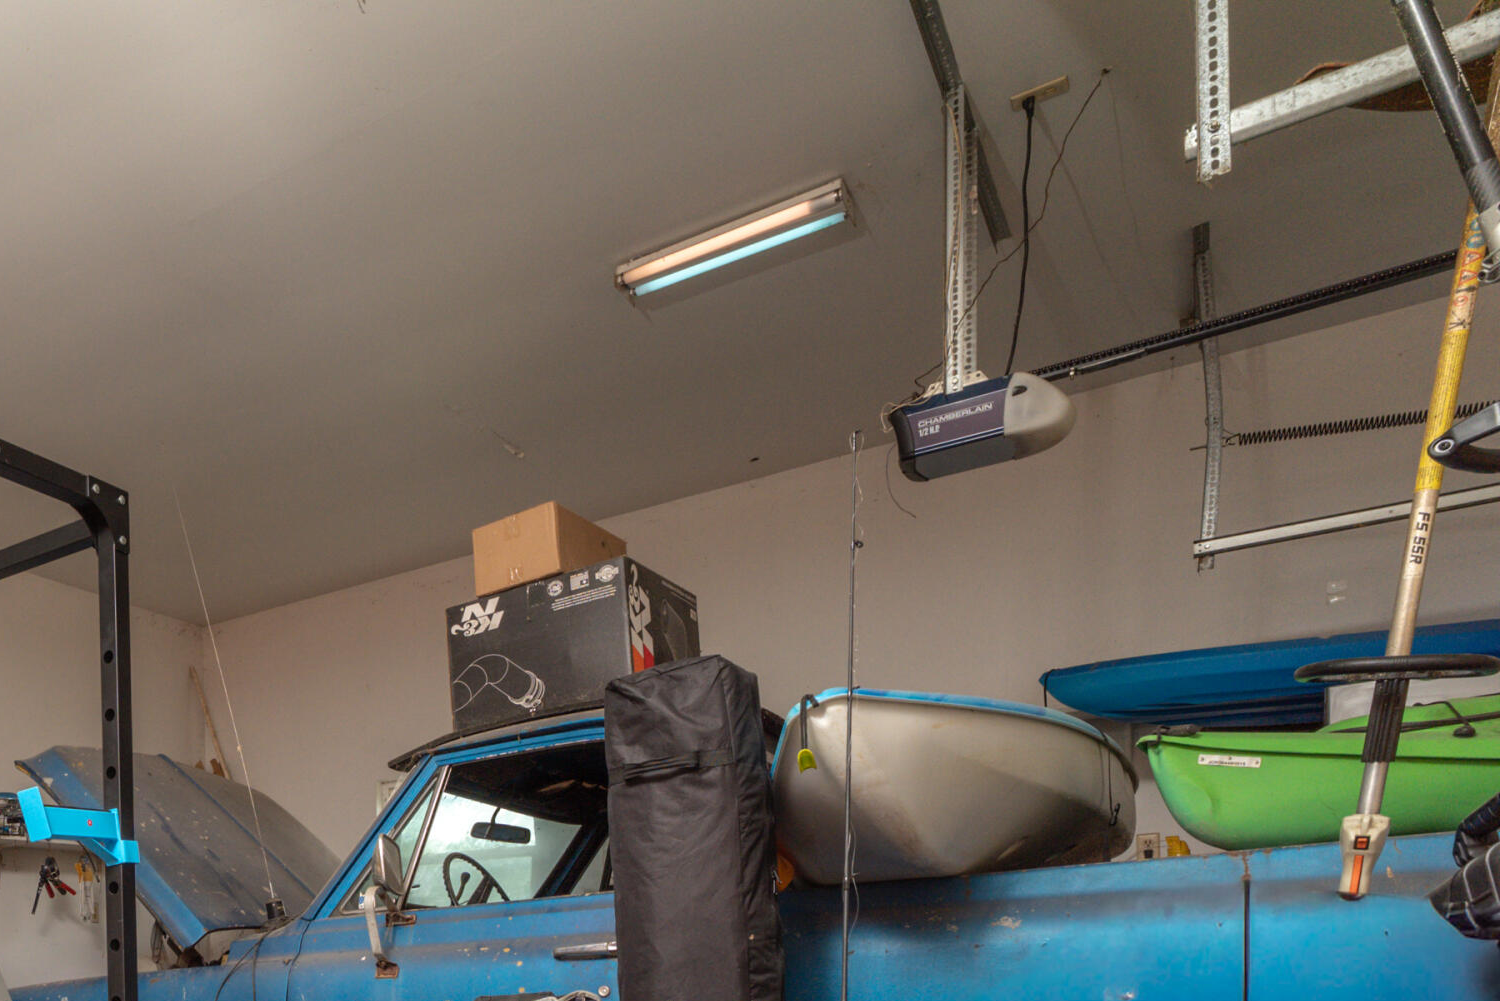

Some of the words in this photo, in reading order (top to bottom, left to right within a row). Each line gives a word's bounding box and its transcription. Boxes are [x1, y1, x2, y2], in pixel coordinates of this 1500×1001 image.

[918, 402, 994, 428] CHAMBERLAIN
[1416, 511, 1431, 532] FS
[1409, 536, 1427, 565] 55R
